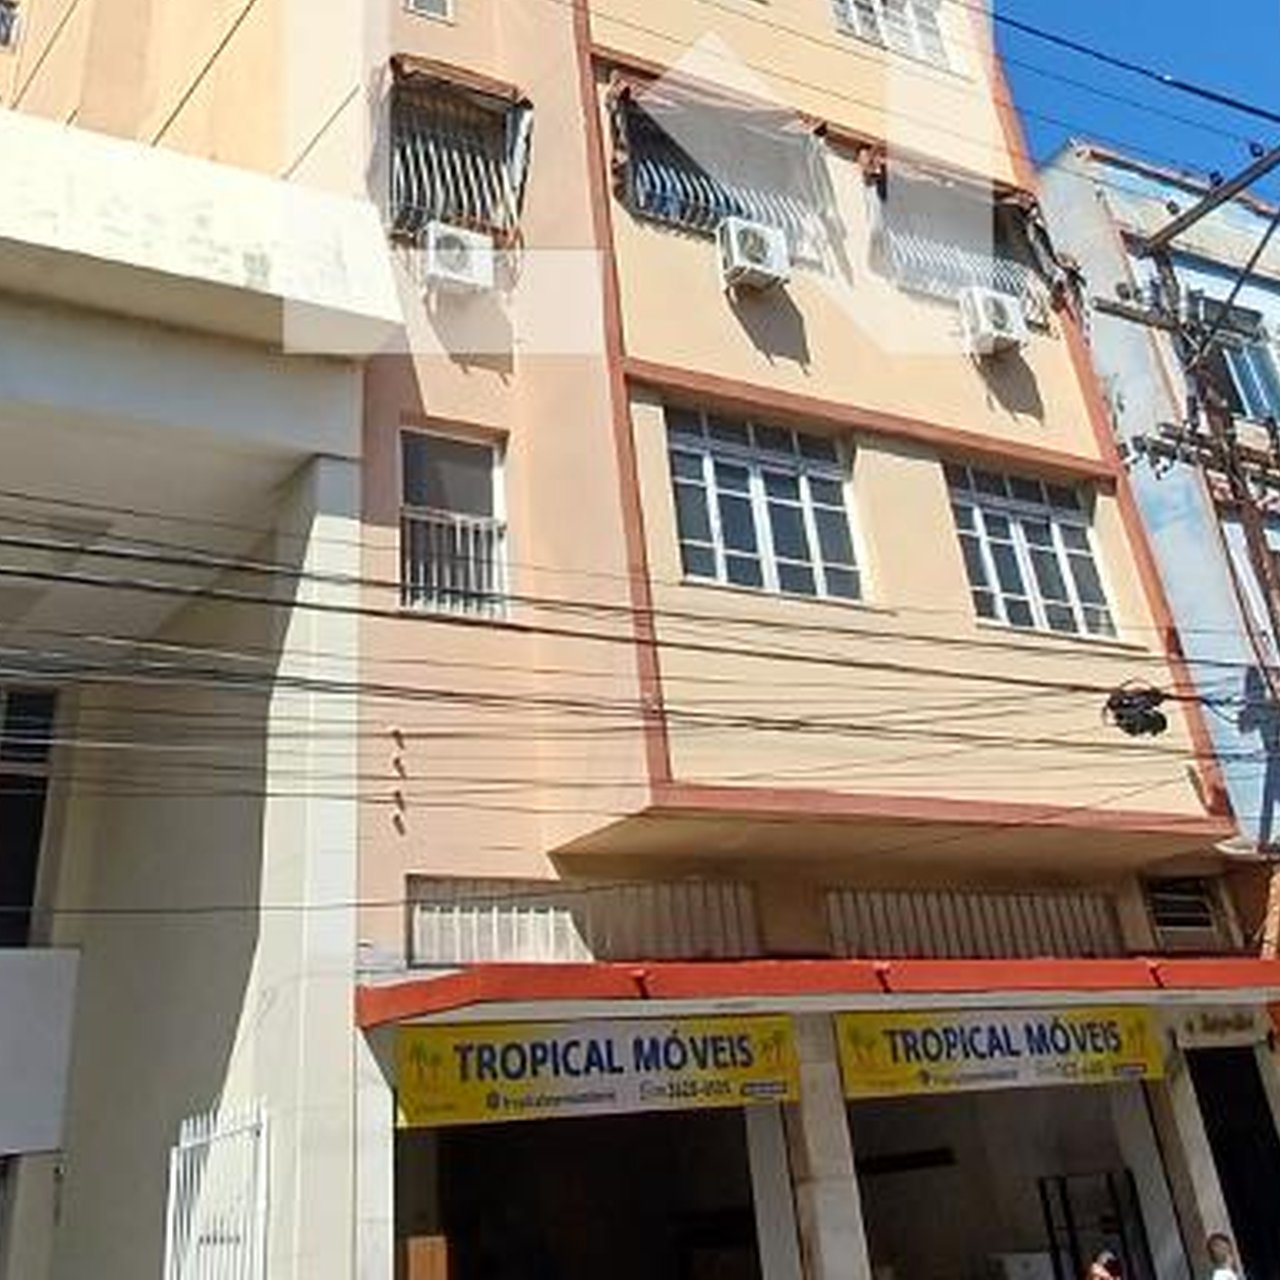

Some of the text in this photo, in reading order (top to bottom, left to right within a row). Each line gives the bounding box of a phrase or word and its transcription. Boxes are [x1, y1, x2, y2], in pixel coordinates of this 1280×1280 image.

[454, 1028, 755, 1082] TROPICAL MÓVEIS
[882, 1015, 1123, 1064] TROPICAL MÓVEIS
